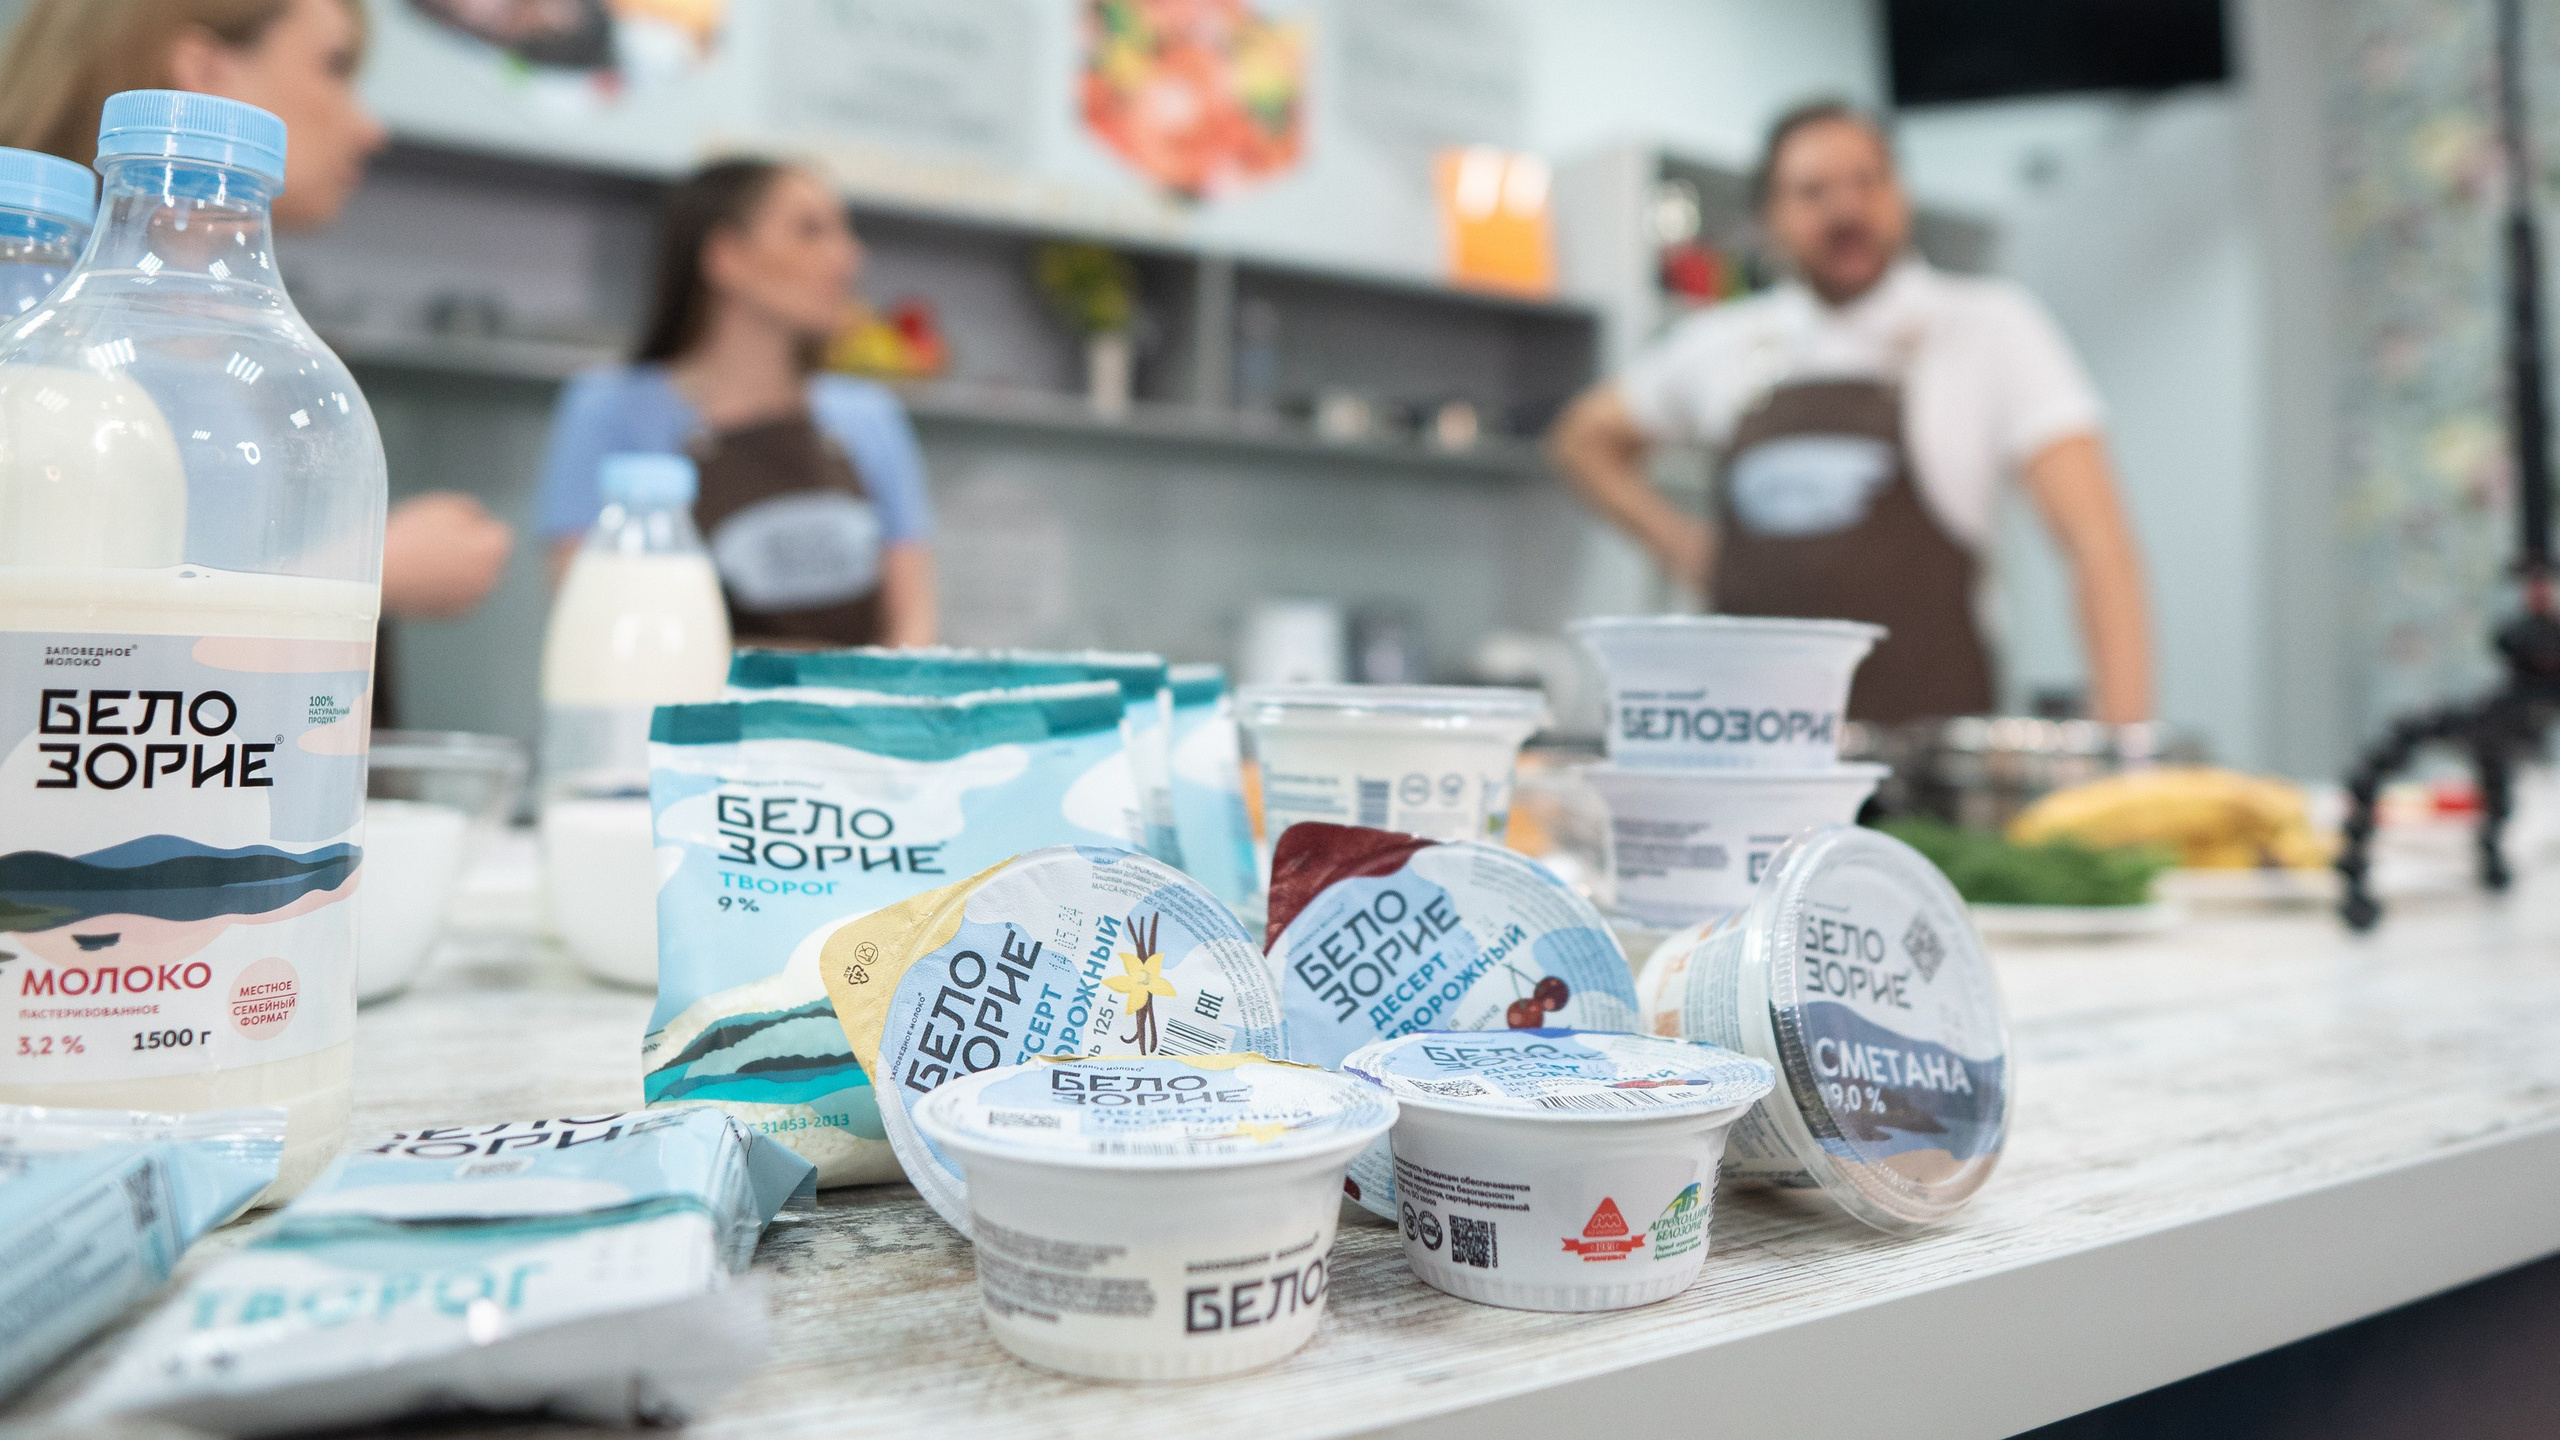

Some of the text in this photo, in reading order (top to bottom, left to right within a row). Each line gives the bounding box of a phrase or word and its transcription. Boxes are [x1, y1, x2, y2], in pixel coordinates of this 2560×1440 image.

[44, 658, 102, 667] МОЛОКО
[45, 646, 132, 657] ЗАПОВЕДНОЕ
[39, 689, 238, 737] БЕЛО
[309, 696, 335, 707] 100%
[308, 716, 337, 725] ПРОДУКТ
[1621, 707, 1836, 743] БЕЛОЗОРИ
[35, 742, 277, 790] ЗОРИЕ
[717, 794, 894, 841] БЕЛО
[717, 829, 947, 874] ЗОРИЕ
[718, 871, 840, 895] ТВОРОГ
[1091, 882, 1118, 892] МАССА
[1118, 887, 1142, 900] НЕТТО
[717, 896, 761, 913] 9 %
[1295, 889, 1408, 992] БЕЛО
[1804, 914, 1886, 964] БЕЛО
[1320, 895, 1462, 1024] ЗОРИЕ
[21, 961, 213, 997] МОЛОКО
[239, 980, 292, 997] МЕСТНОЕ
[1053, 914, 1122, 1056] ОРОЖНЫЙ
[1369, 951, 1450, 1030] ДЕСЕРТ
[1804, 956, 1913, 1010] ЗОРИЕ
[19, 1004, 161, 1020] ПАСТЕРИЗОВАННОЕ
[233, 997, 296, 1016] СЕМЕЙНЫЙ
[240, 1011, 289, 1026] ФОРМАТ
[953, 929, 1042, 1080] ОРИЕ
[1093, 1007, 1114, 1036] 125
[1108, 994, 1118, 1005] г
[905, 951, 987, 1093] БЕЛО
[17, 1035, 85, 1057] 3,2 %
[132, 1028, 212, 1050] 1500 г
[890, 997, 926, 1081] ЗАПОВЕДНОЕ МОЛОКО
[1421, 1043, 1560, 1062] БЕЛО
[1051, 1069, 1208, 1092] БЕЛО
[1815, 1037, 1974, 1096] СМЕТАНА
[1864, 1086, 1888, 1114] %
[761, 1113, 850, 1135] 31453-2013
[1457, 1185, 1515, 1200] безопасности
